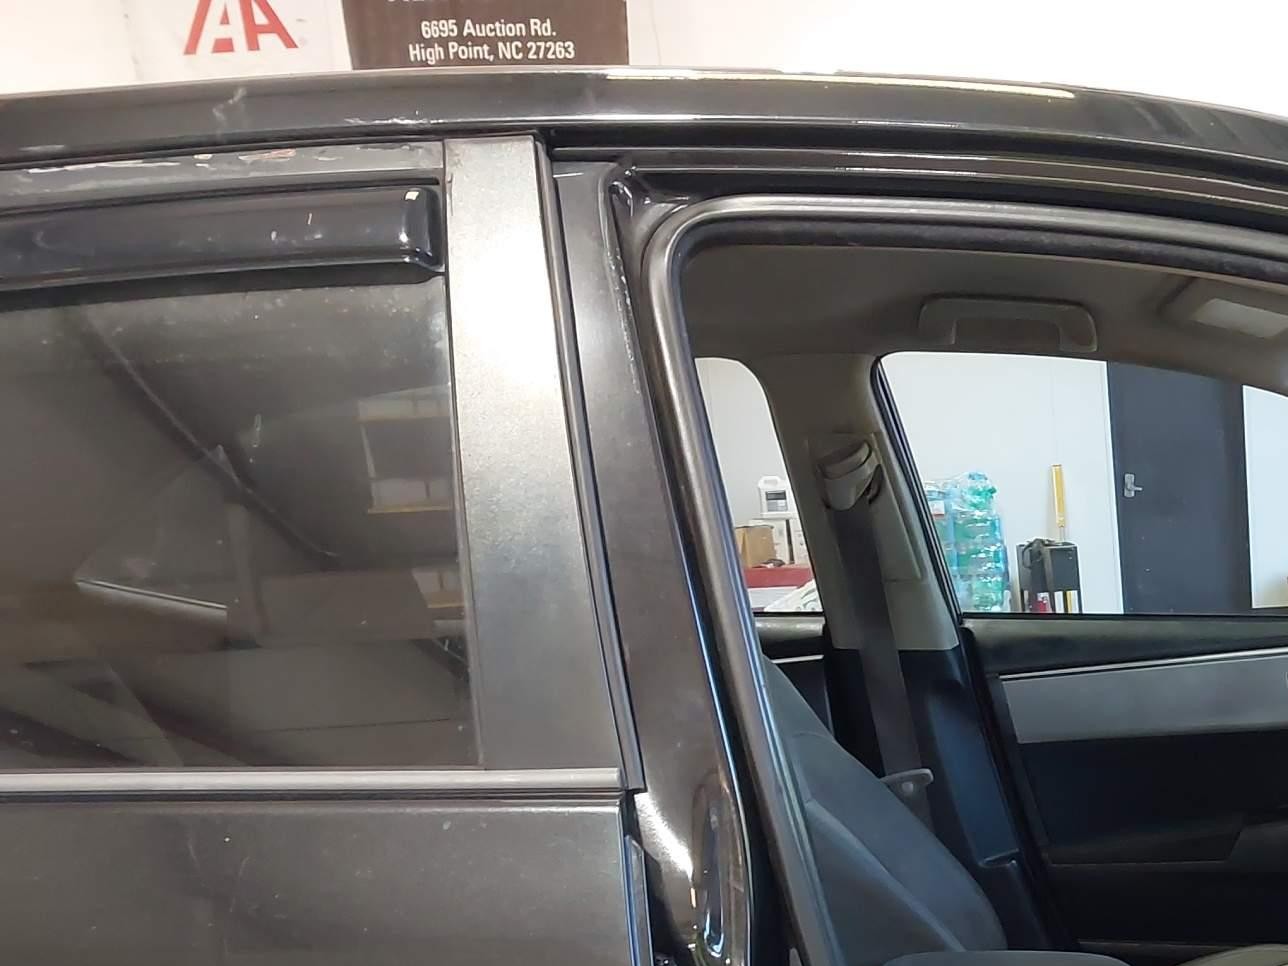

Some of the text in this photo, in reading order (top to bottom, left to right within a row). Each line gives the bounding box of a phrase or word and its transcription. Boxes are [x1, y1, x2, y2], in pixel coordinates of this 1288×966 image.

[420, 18, 557, 39] 6695 Auction Rd.
[408, 41, 575, 66] High Point, NC 27263
